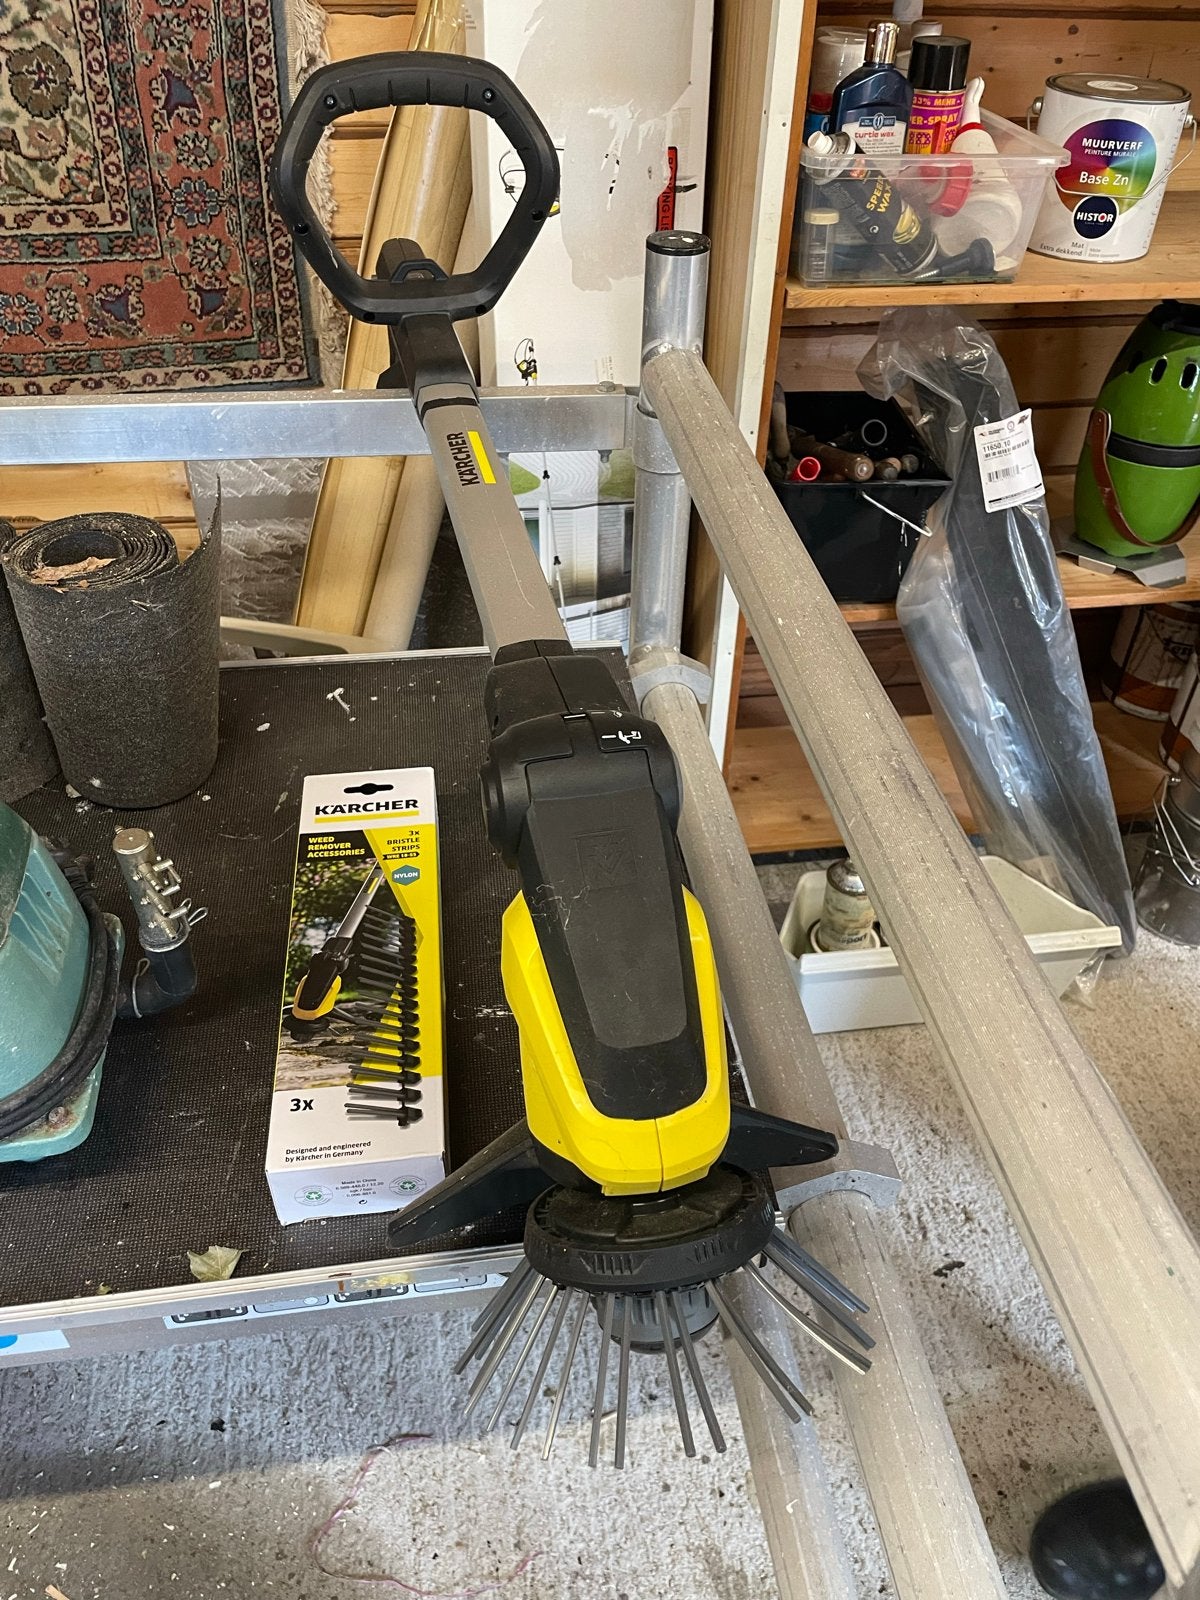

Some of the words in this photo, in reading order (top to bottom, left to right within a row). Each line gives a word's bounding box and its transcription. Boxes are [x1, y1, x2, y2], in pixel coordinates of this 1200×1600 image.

[910, 112, 959, 125] ER-SPRAY
[1082, 138, 1143, 150] MUURVERF
[1084, 149, 1112, 157] PEINTURE
[1079, 171, 1110, 185] Base
[1112, 174, 1129, 186] Zn
[877, 183, 892, 213] WAX
[1076, 212, 1114, 223] HISTOR
[1056, 247, 1083, 256] dekkend
[446, 432, 480, 486] KÄRCHER
[314, 799, 419, 816] KÄRCHER
[308, 836, 335, 844] WEED
[387, 837, 420, 845] BRISTLE
[307, 842, 352, 851] REMOVER
[392, 844, 420, 852] STRIPS
[307, 848, 365, 858] ACCESSORIES
[285, 1147, 318, 1155] Designed
[332, 1141, 372, 1150] engineered
[295, 1153, 323, 1162] Kärcher
[332, 1149, 364, 1159] Germany
